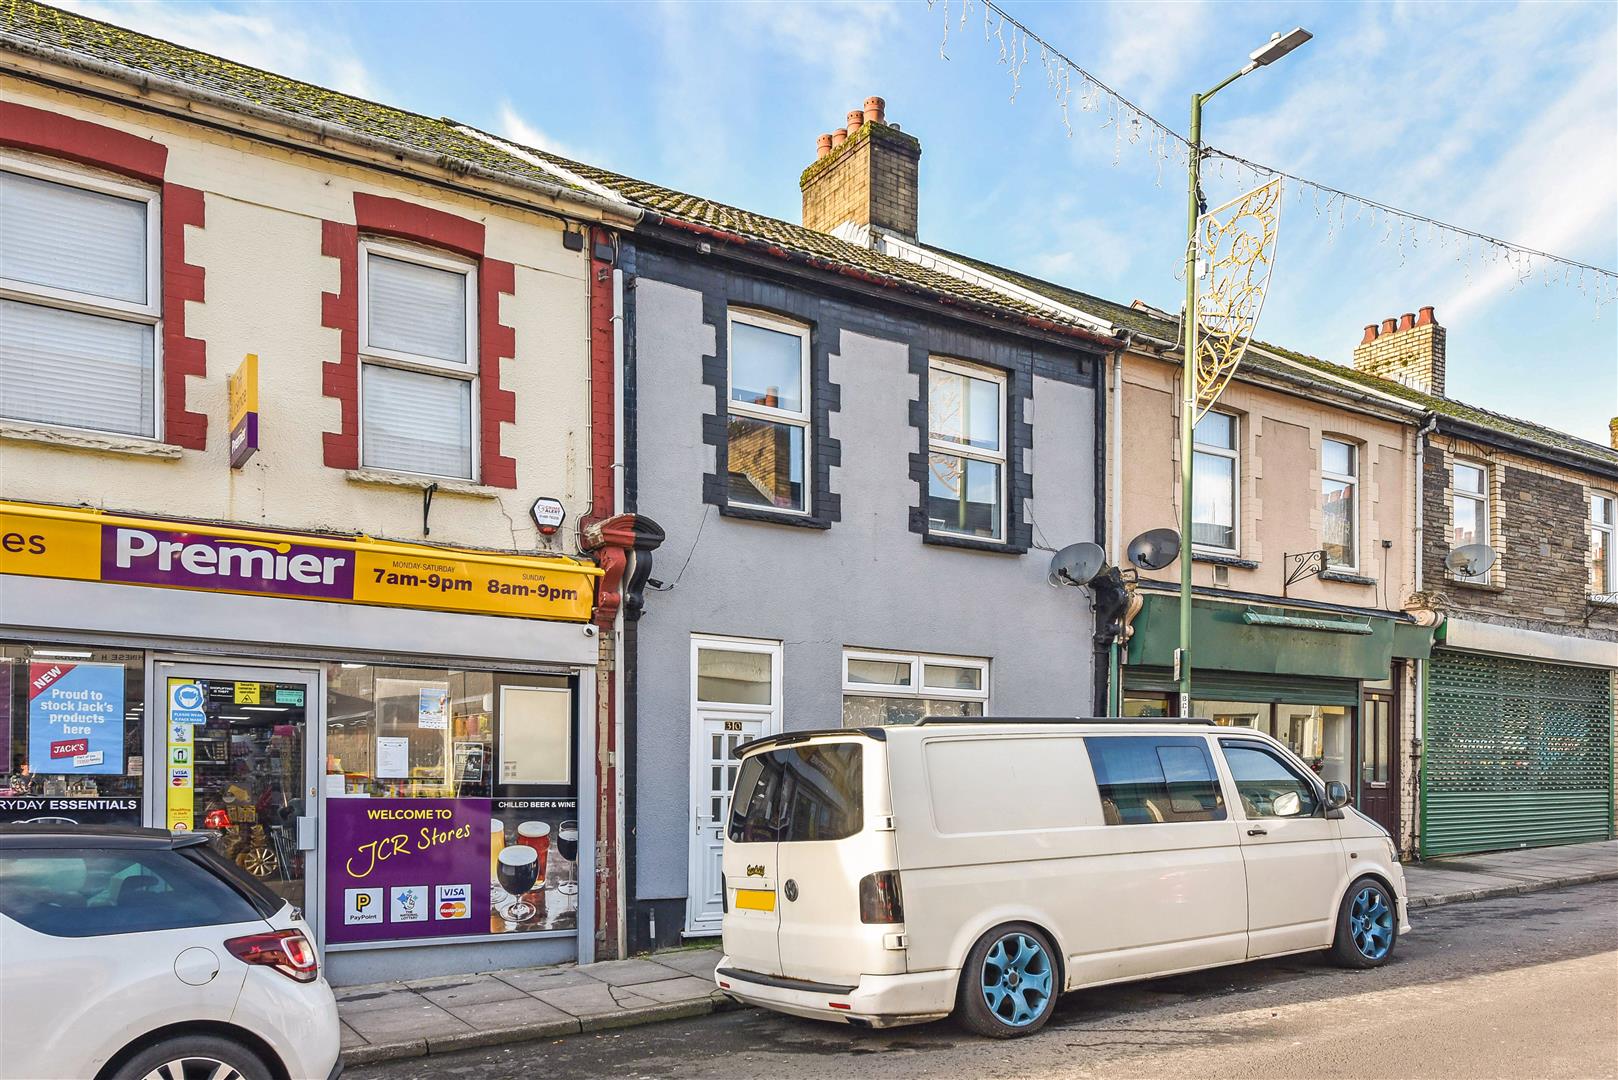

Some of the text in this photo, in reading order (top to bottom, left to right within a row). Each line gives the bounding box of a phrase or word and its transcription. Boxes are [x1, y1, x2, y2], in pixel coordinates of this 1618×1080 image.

[116, 528, 345, 585] Premier
[392, 560, 455, 574] MONDAY-SATURDAY
[373, 568, 473, 592] 7am-9pm
[522, 573, 546, 582] SUNDAY
[487, 580, 578, 601] 8am-9pm
[33, 665, 62, 689] NEW
[52, 688, 103, 701] Proud to
[40, 700, 114, 712] stock Jack's
[49, 712, 105, 724] products
[63, 723, 91, 735] here
[726, 721, 741, 730] 30
[54, 743, 85, 754] JACK'S
[50, 801, 137, 810] ESSENTIALS
[367, 809, 452, 820] WELCOME TO
[346, 824, 470, 878] JCR Stores
[444, 888, 465, 896] VISA
